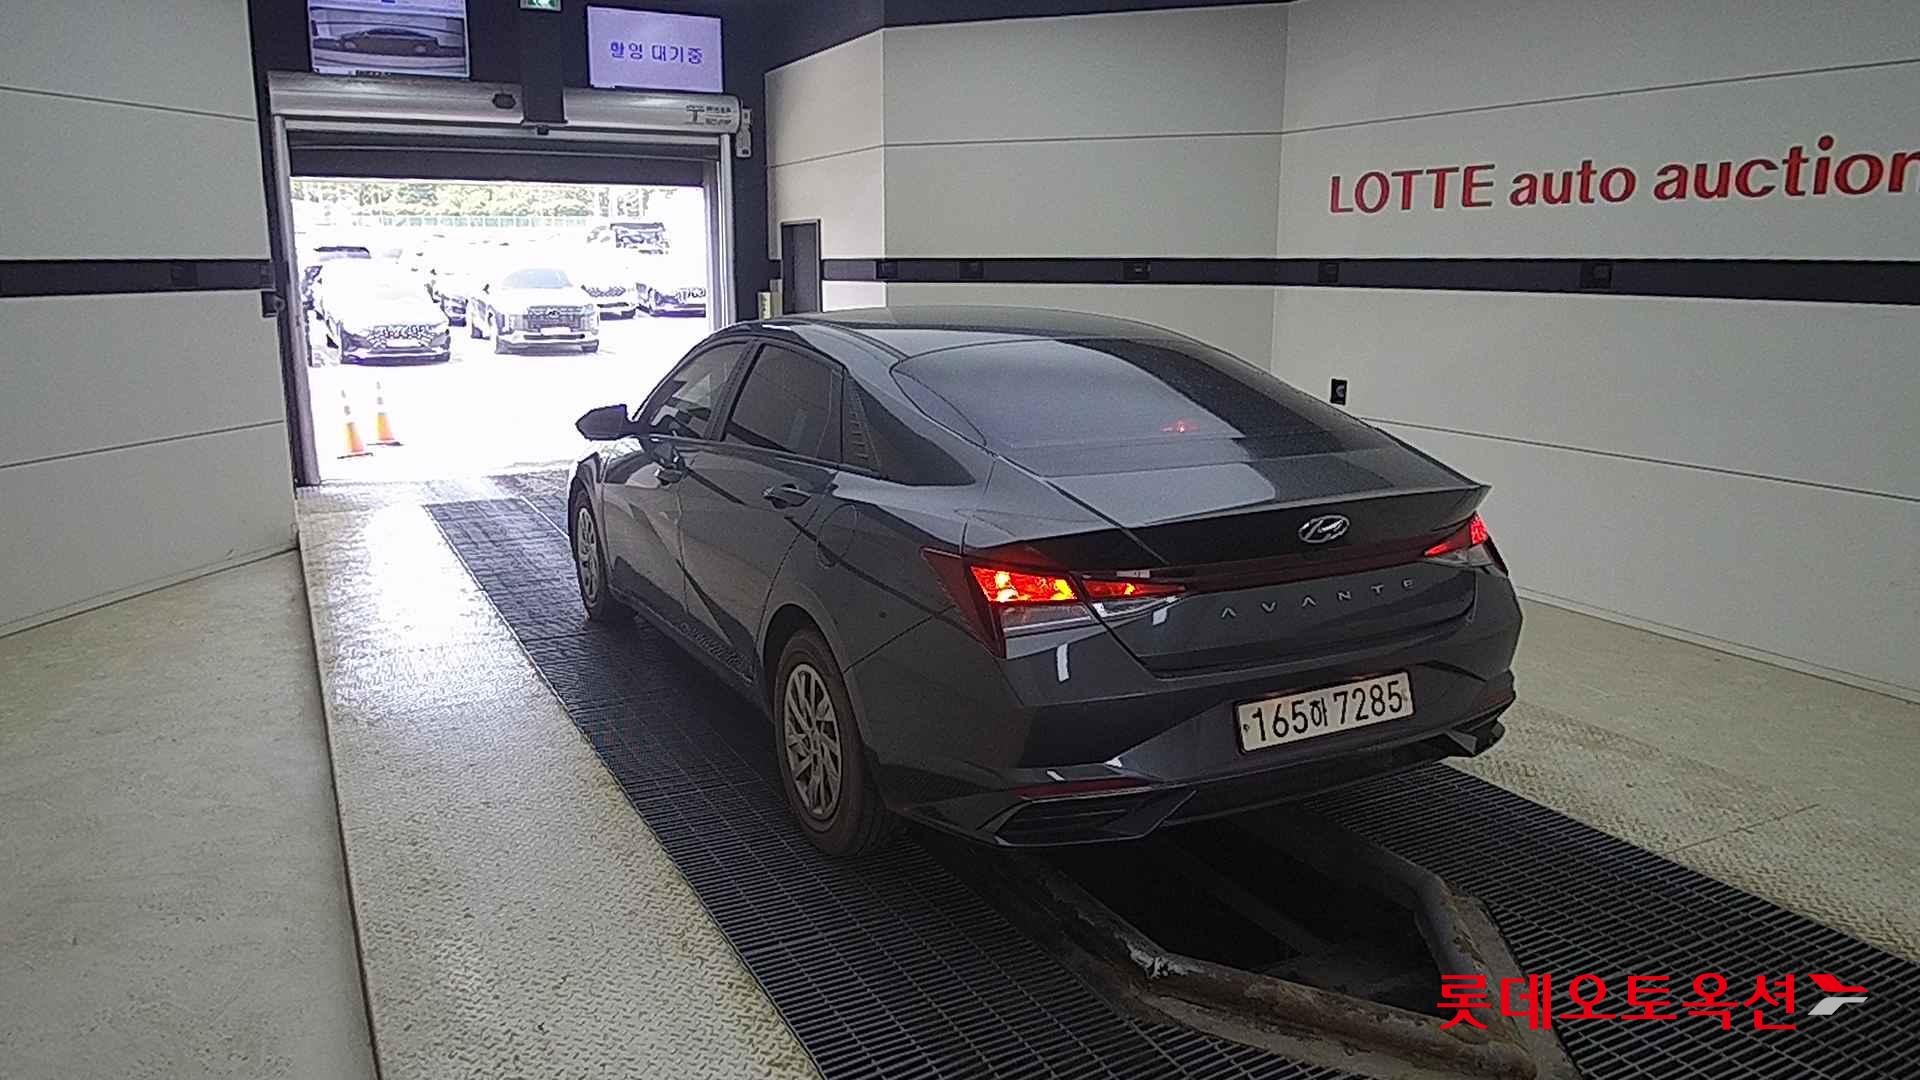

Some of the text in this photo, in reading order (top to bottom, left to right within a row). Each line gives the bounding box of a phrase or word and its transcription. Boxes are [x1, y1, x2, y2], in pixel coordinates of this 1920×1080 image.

[1330, 164, 1495, 214] LOTTE
[1509, 160, 1637, 206] auto
[1220, 578, 1415, 619] AVANTE
